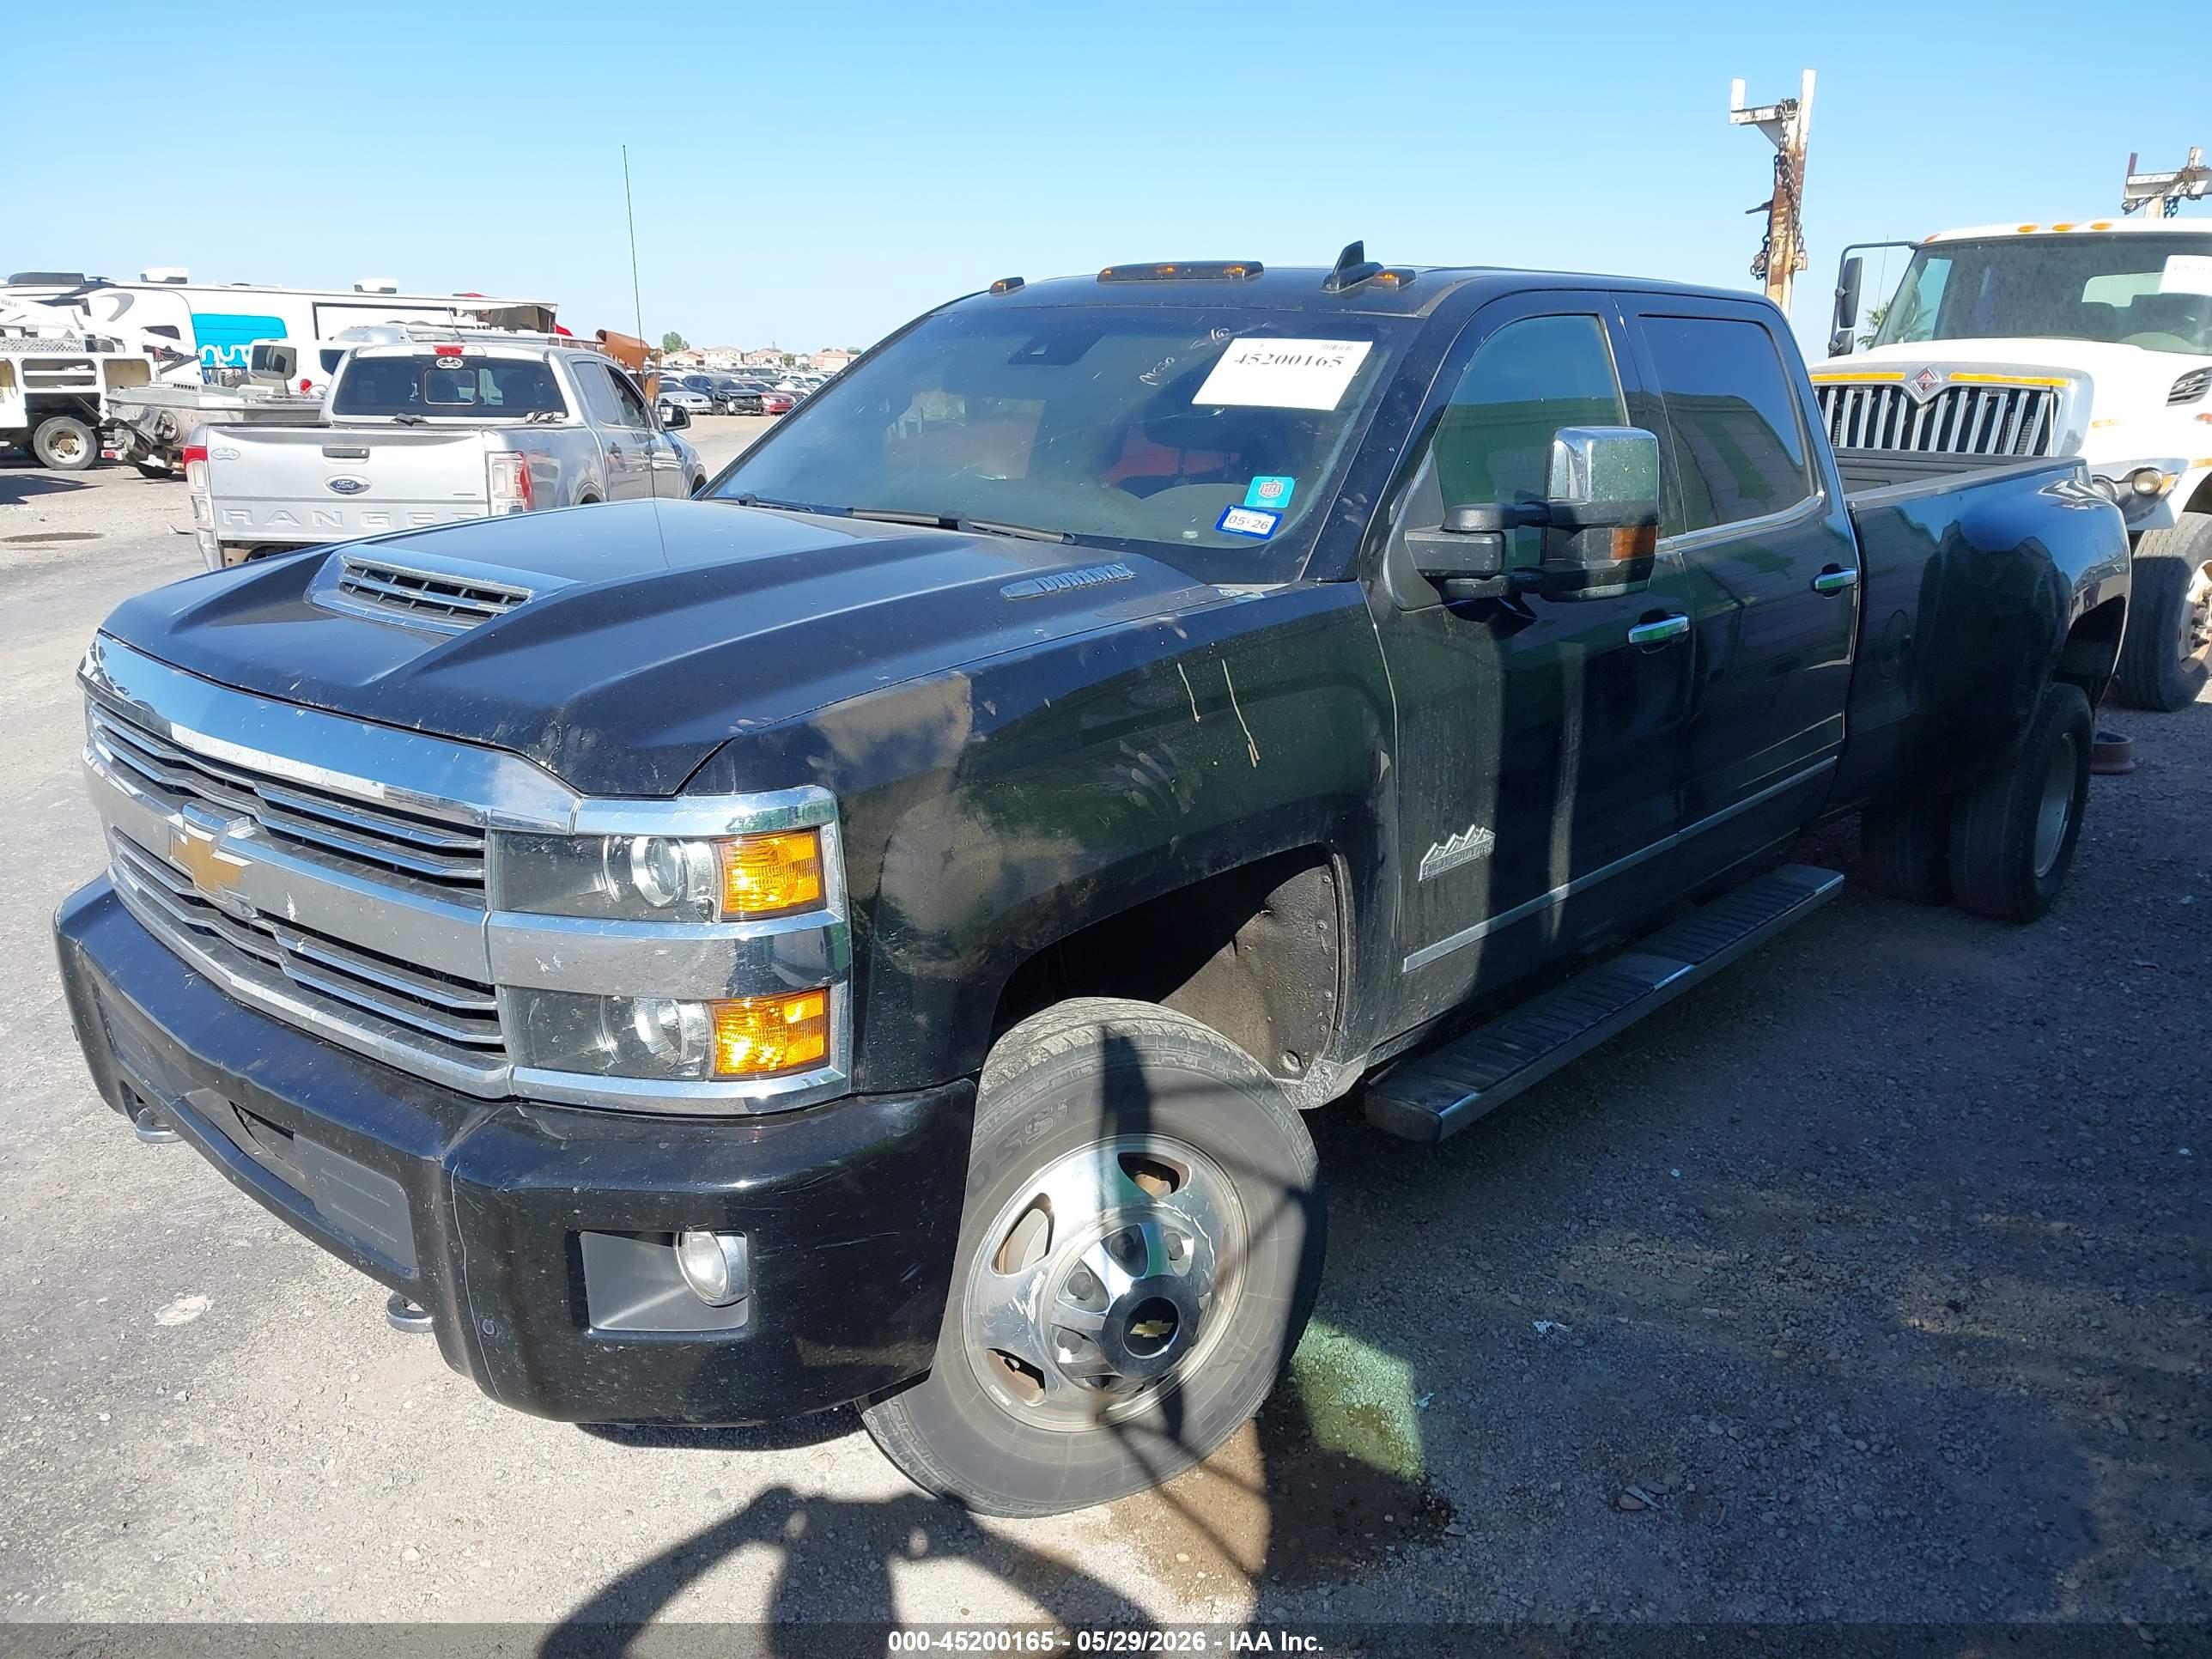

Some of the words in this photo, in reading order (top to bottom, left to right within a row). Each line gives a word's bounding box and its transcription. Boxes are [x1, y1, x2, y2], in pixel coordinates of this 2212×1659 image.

[1234, 353, 1346, 368] 45200165
[1228, 515, 1248, 526] 05
[1251, 519, 1270, 530] 26
